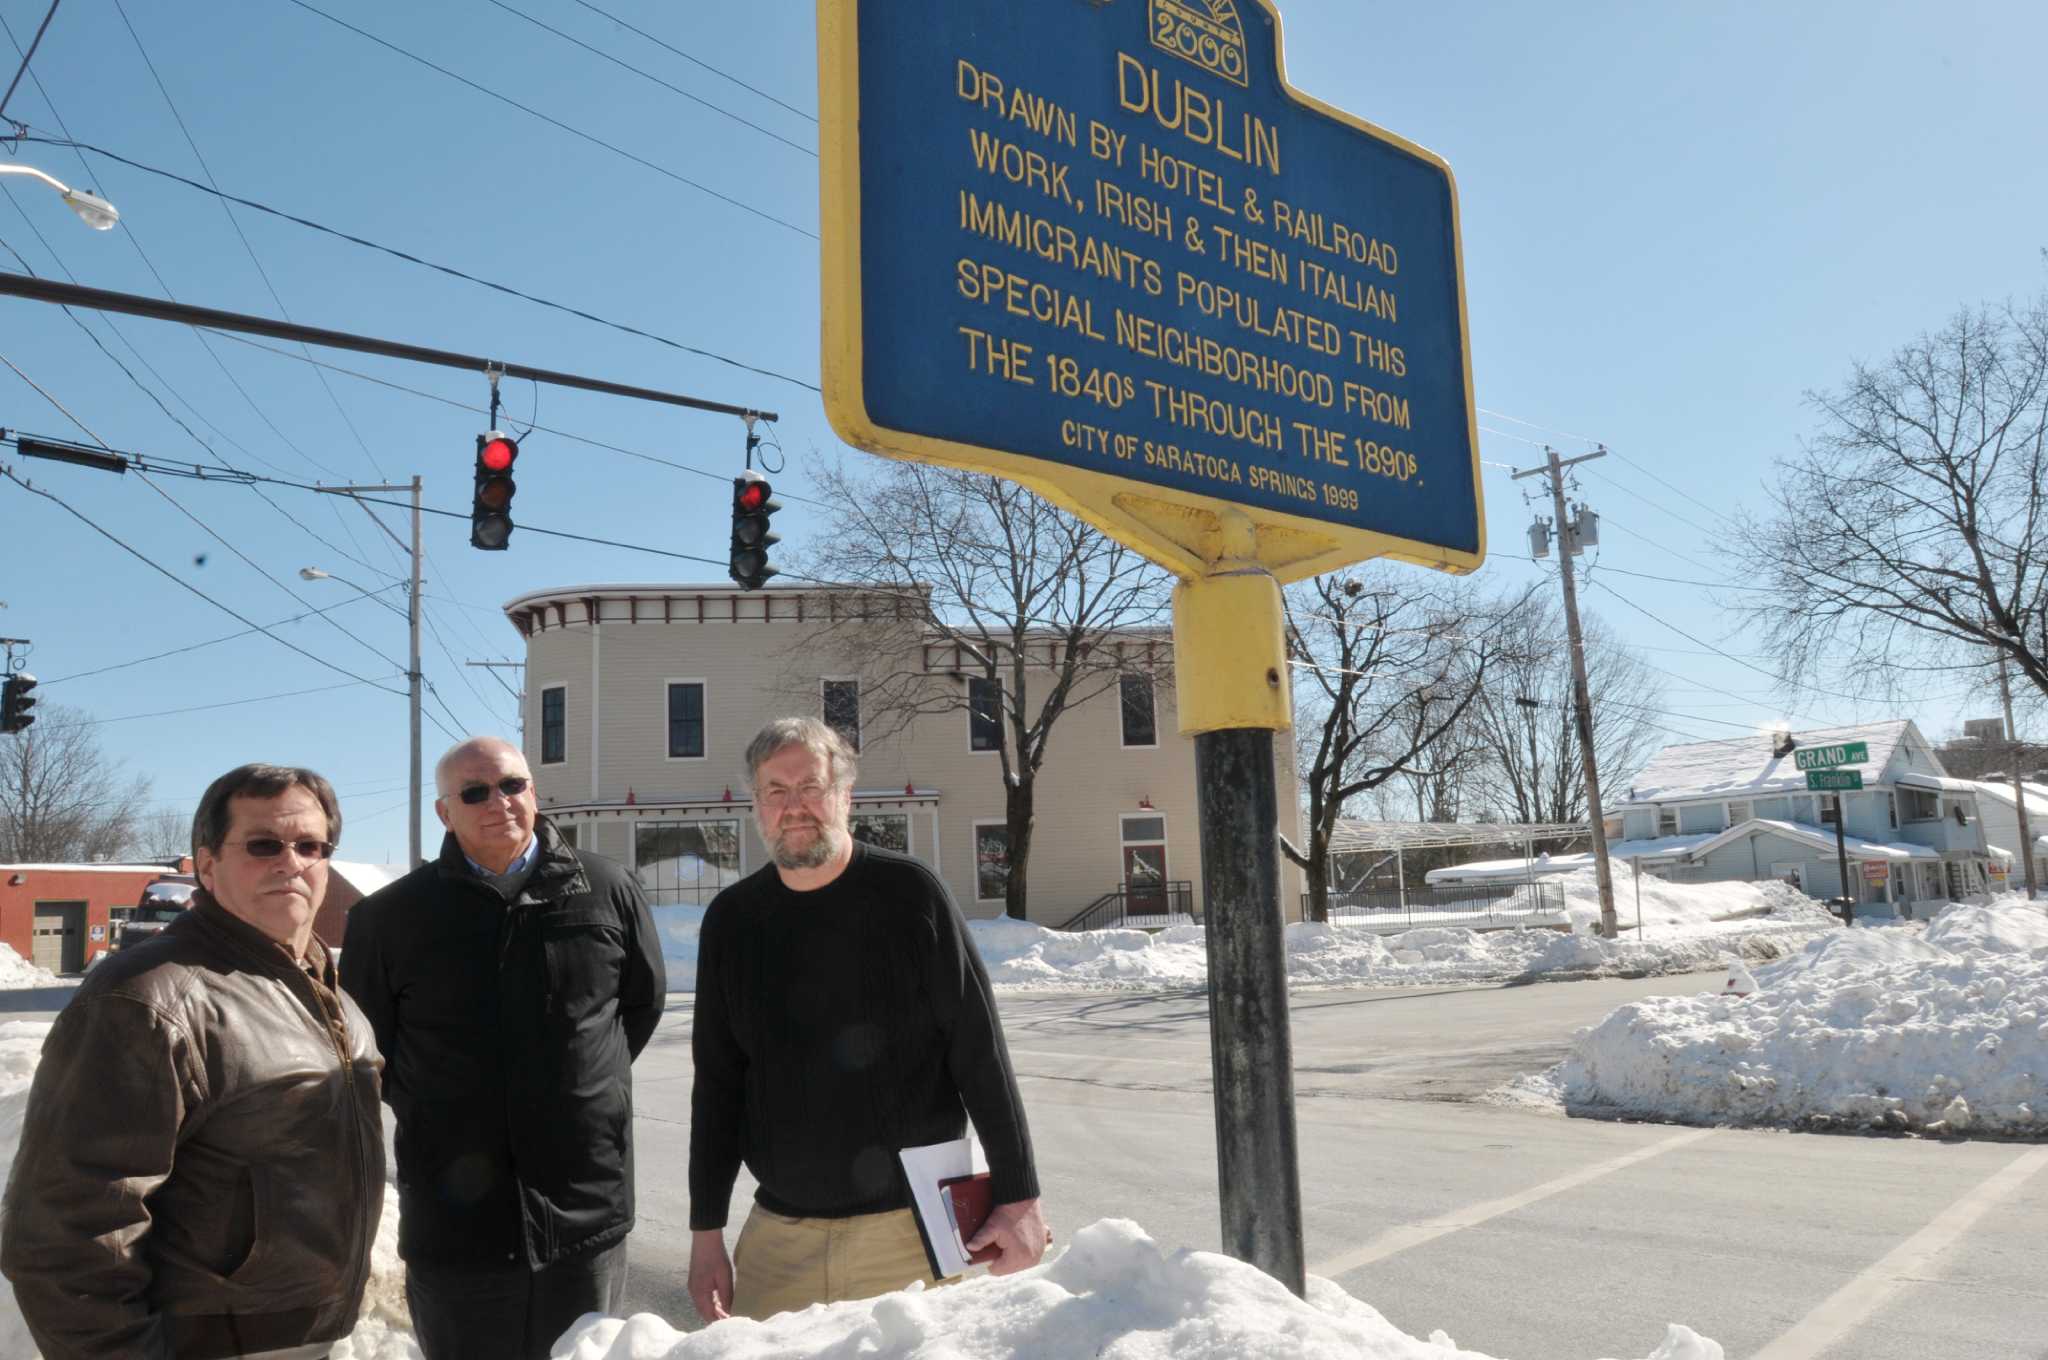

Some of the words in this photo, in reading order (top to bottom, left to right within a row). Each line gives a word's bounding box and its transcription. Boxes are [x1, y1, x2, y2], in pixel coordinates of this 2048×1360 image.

[1116, 53, 1281, 176] DUBLIN
[1157, 13, 1242, 76] 2000
[958, 58, 1077, 148] DRAWN
[1089, 120, 1127, 168] BY
[1140, 144, 1236, 216] HOTEL
[1243, 186, 1266, 224] &
[1272, 200, 1399, 276] RAILROAD
[969, 128, 1086, 214] WORK,
[1095, 179, 1173, 241] IRISH
[1184, 216, 1206, 253] &
[1213, 225, 1289, 285] THEN
[1299, 259, 1398, 323] ITALIAN
[955, 258, 1105, 341] SPECIAL
[1115, 309, 1334, 407] NEIGHBORHOOD
[1343, 380, 1411, 431] FROM
[960, 191, 1163, 296] IMMIGRANTS
[1177, 272, 1341, 355] POPULATED
[1349, 330, 1408, 378] THIS
[960, 326, 1036, 384] THE
[1145, 381, 1283, 450] THROUGH
[1293, 421, 1350, 468] THE
[1061, 419, 1109, 454] CITY
[1113, 432, 1139, 460] OF
[1143, 439, 1242, 482] SARATOGA
[1248, 465, 1317, 504] SPRINGS
[1322, 483, 1360, 513] 1999
[1797, 746, 1846, 768] GRAND
[1851, 751, 1866, 761] AVE
